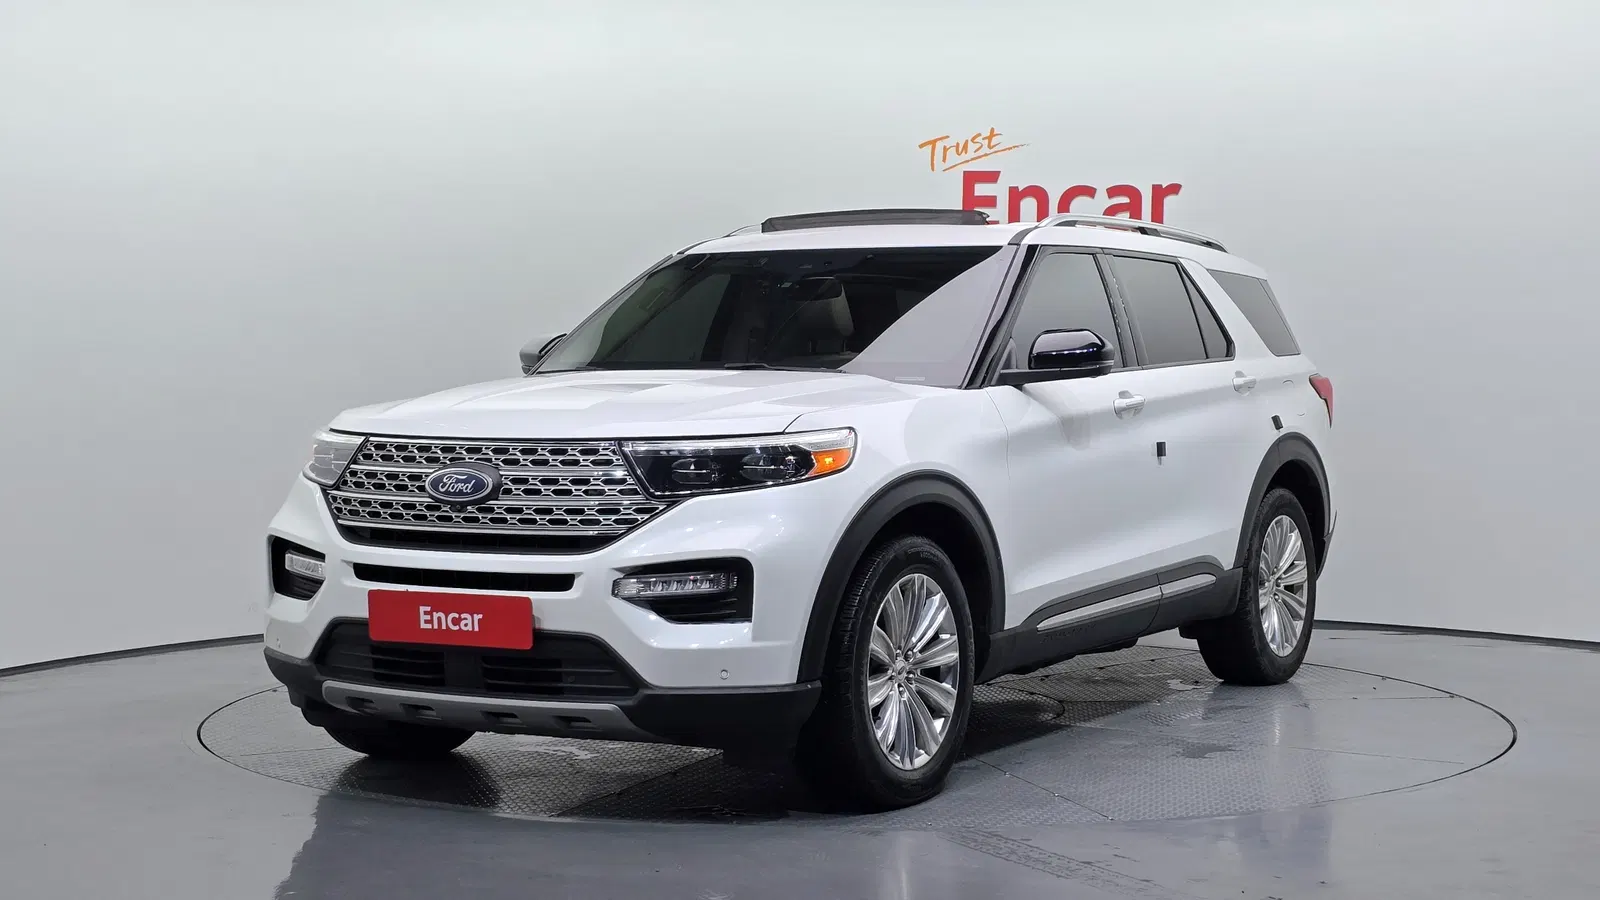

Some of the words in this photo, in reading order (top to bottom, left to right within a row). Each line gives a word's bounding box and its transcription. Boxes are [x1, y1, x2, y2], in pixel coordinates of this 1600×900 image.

[918, 127, 1003, 172] Trust
[962, 170, 1183, 226] Encar
[438, 474, 476, 493] Ford
[419, 605, 483, 632] Encar
